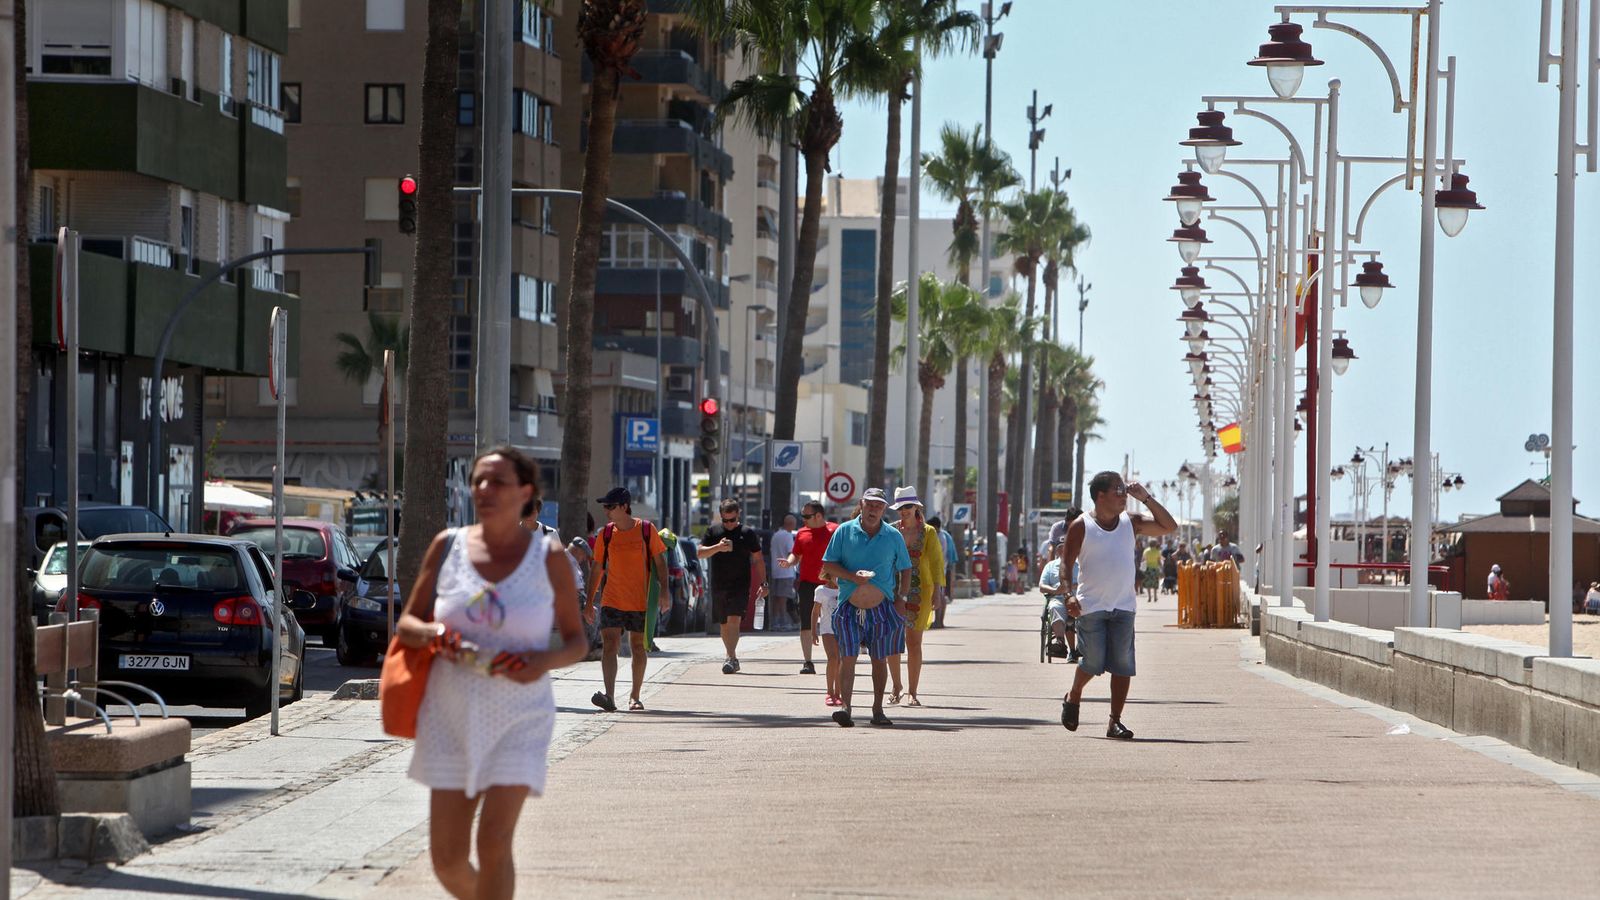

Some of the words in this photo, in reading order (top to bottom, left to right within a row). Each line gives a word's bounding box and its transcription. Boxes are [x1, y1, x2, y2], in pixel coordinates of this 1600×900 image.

[633, 421, 650, 441] P
[830, 482, 850, 493] 40
[128, 656, 160, 668] 3277
[162, 657, 187, 669] GJN
